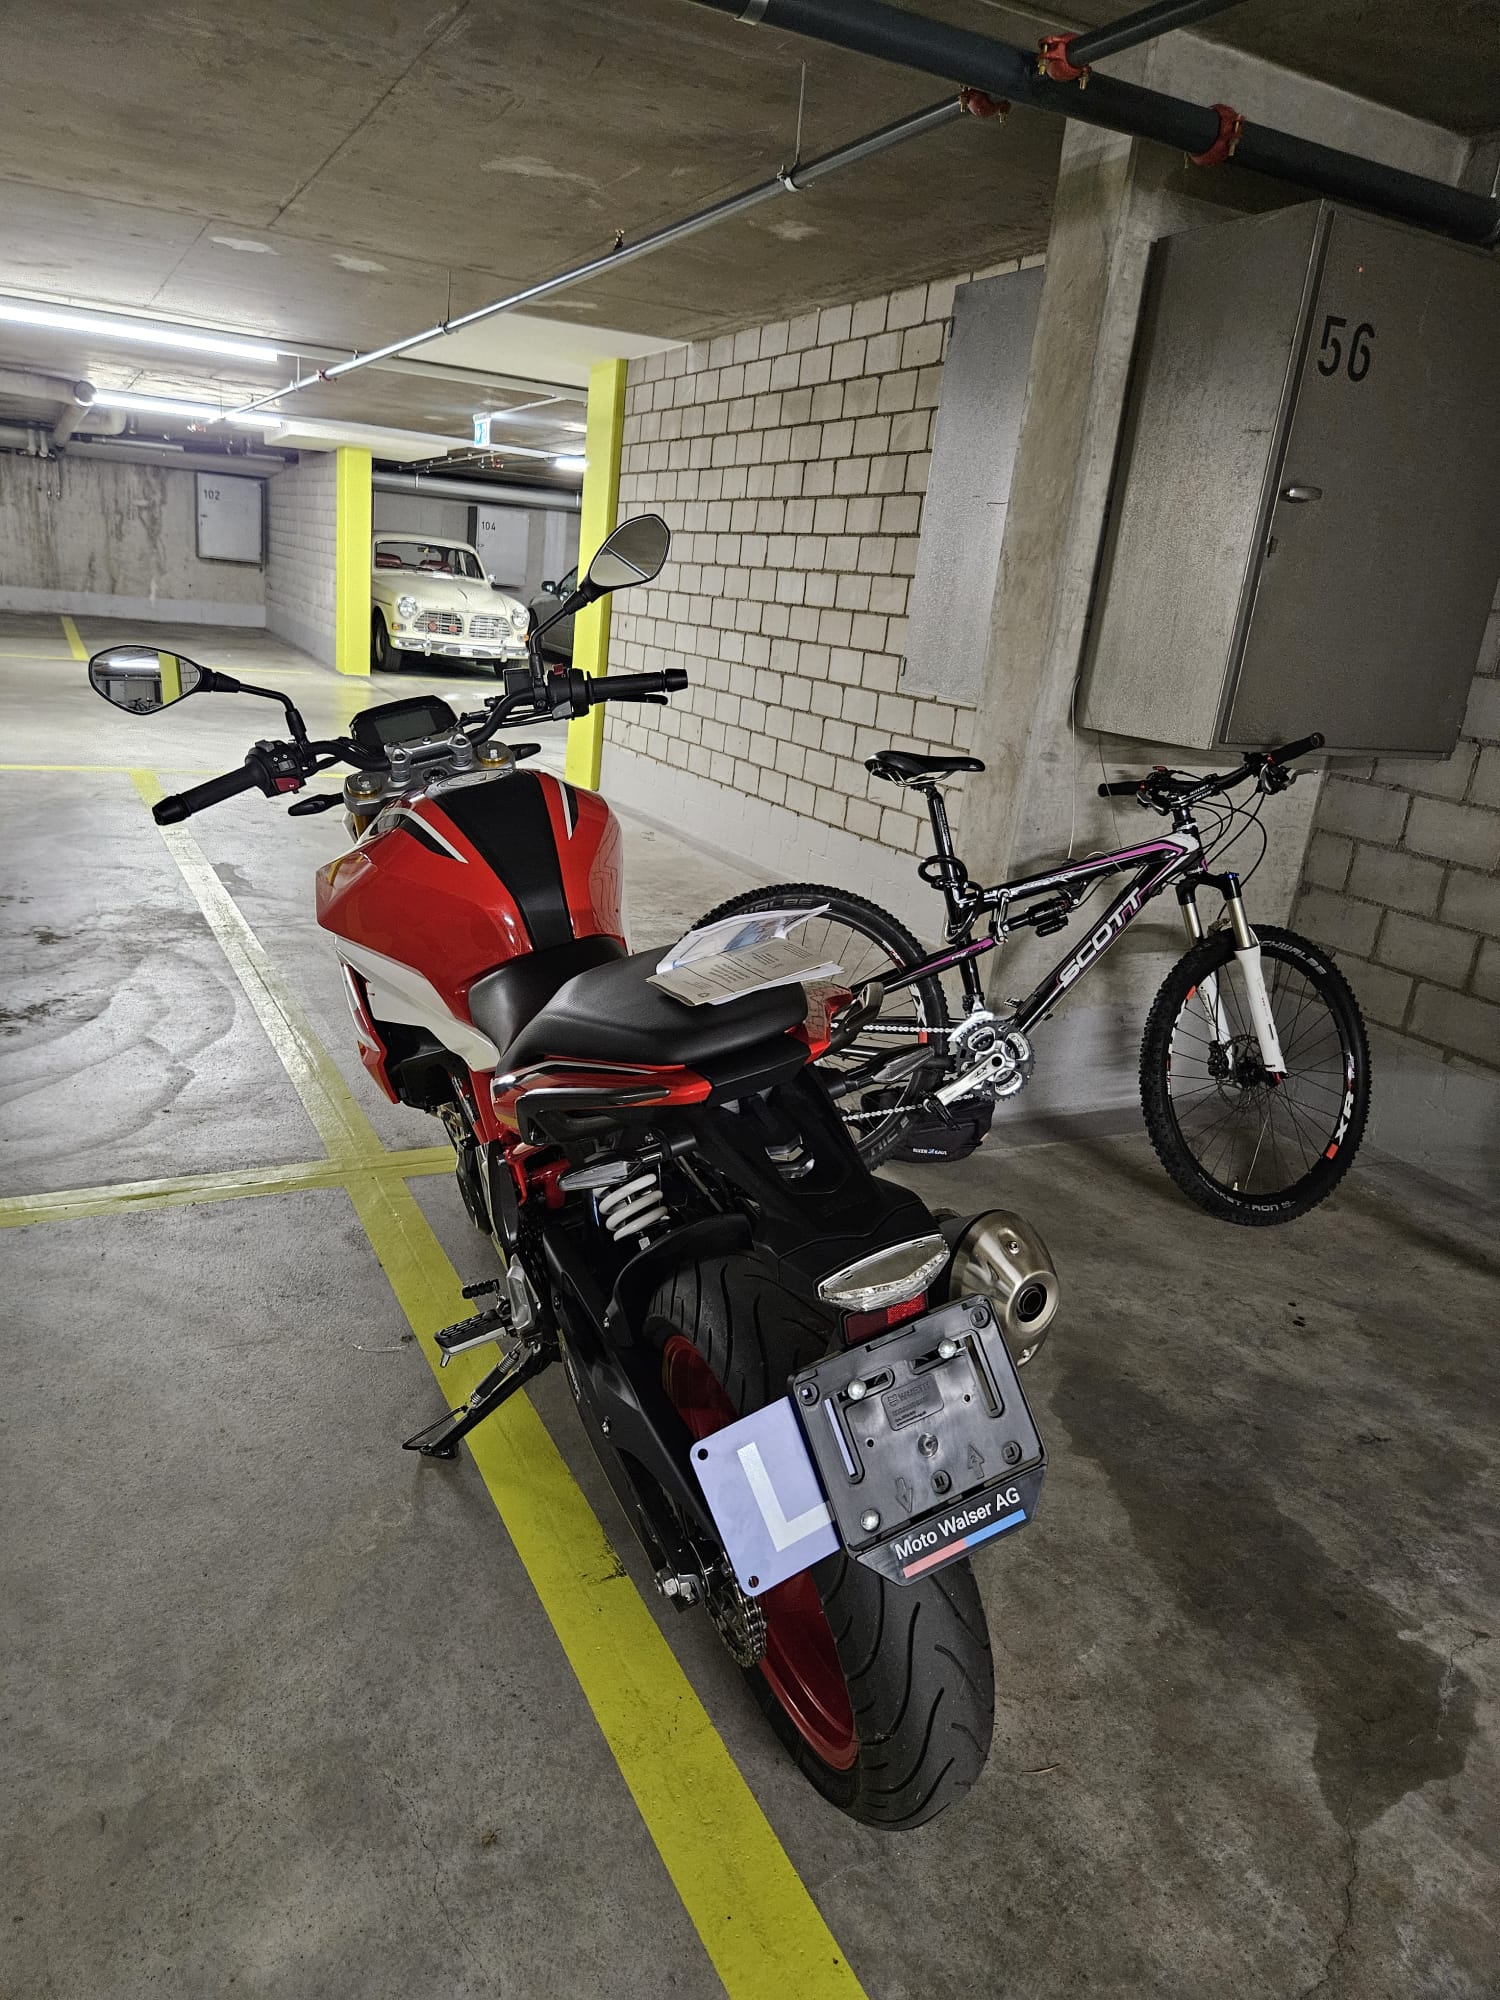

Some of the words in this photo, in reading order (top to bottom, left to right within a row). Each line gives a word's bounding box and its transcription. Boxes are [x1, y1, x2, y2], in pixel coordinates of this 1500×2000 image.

[1318, 314, 1376, 382] 56
[203, 488, 221, 501] 102
[481, 521, 496, 531] 104
[1060, 886, 1141, 988] SCOTT
[1259, 940, 1327, 975] CHWALBE
[736, 1441, 834, 1553] L
[894, 1531, 938, 1560] Moto
[937, 1502, 992, 1537] Walser
[995, 1486, 1021, 1512] AG
